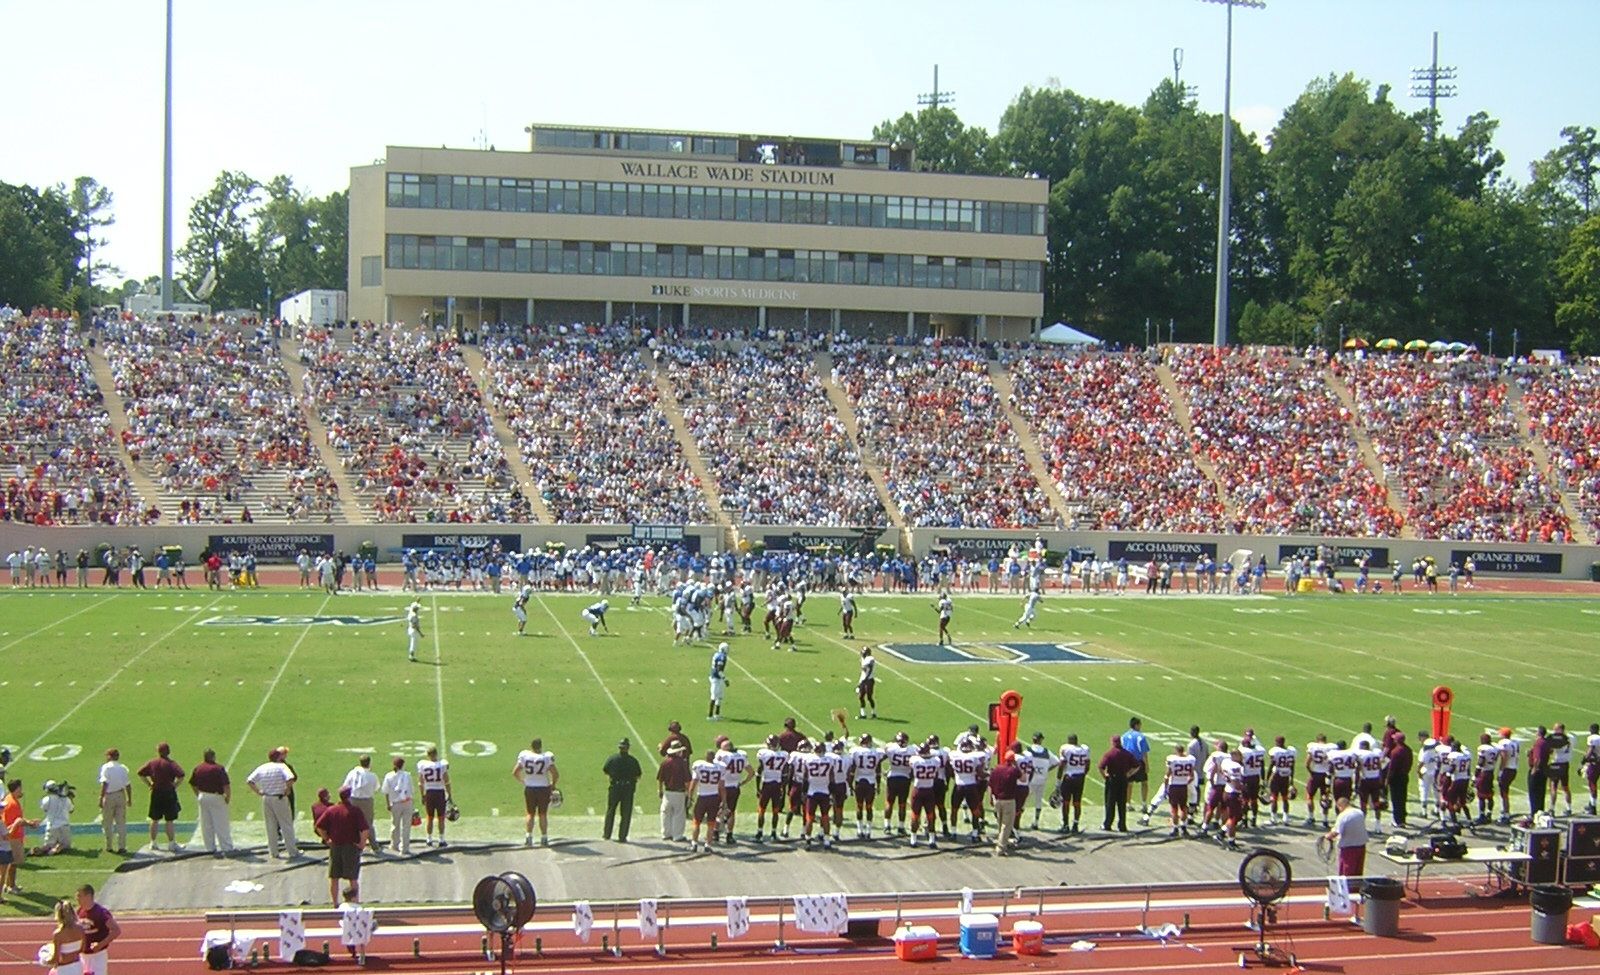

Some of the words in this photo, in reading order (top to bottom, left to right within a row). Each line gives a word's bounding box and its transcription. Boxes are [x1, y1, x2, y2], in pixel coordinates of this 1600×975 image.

[620, 162, 698, 179] WALLACE
[706, 166, 753, 182] WADE
[760, 169, 834, 186] STADIUM
[694, 286, 738, 299] SPORTS
[741, 288, 799, 300] MEDICINE
[222, 536, 267, 544] SOUTHERN
[247, 543, 297, 551] CHAMPIONS
[434, 535, 459, 545] ROSE
[788, 537, 820, 547] SUGAR
[956, 540, 975, 549] ACC
[1125, 543, 1144, 551] ACC
[1145, 543, 1202, 553] CHAMPIONS
[1297, 547, 1315, 556] ACC
[1472, 553, 1513, 562] ORANGE
[1515, 554, 1542, 563] BOWL
[726, 758, 744, 774] 40
[766, 756, 785, 770] 47
[858, 755, 877, 769] 13
[955, 759, 973, 773] 96
[1069, 754, 1087, 766] 55
[1246, 755, 1264, 768] 45
[1333, 756, 1355, 770] 24
[424, 767, 442, 782] 21
[525, 760, 545, 775] 57
[809, 762, 830, 777] 27
[916, 765, 936, 779] 22
[1174, 763, 1192, 776] 29
[700, 770, 721, 784] 33
